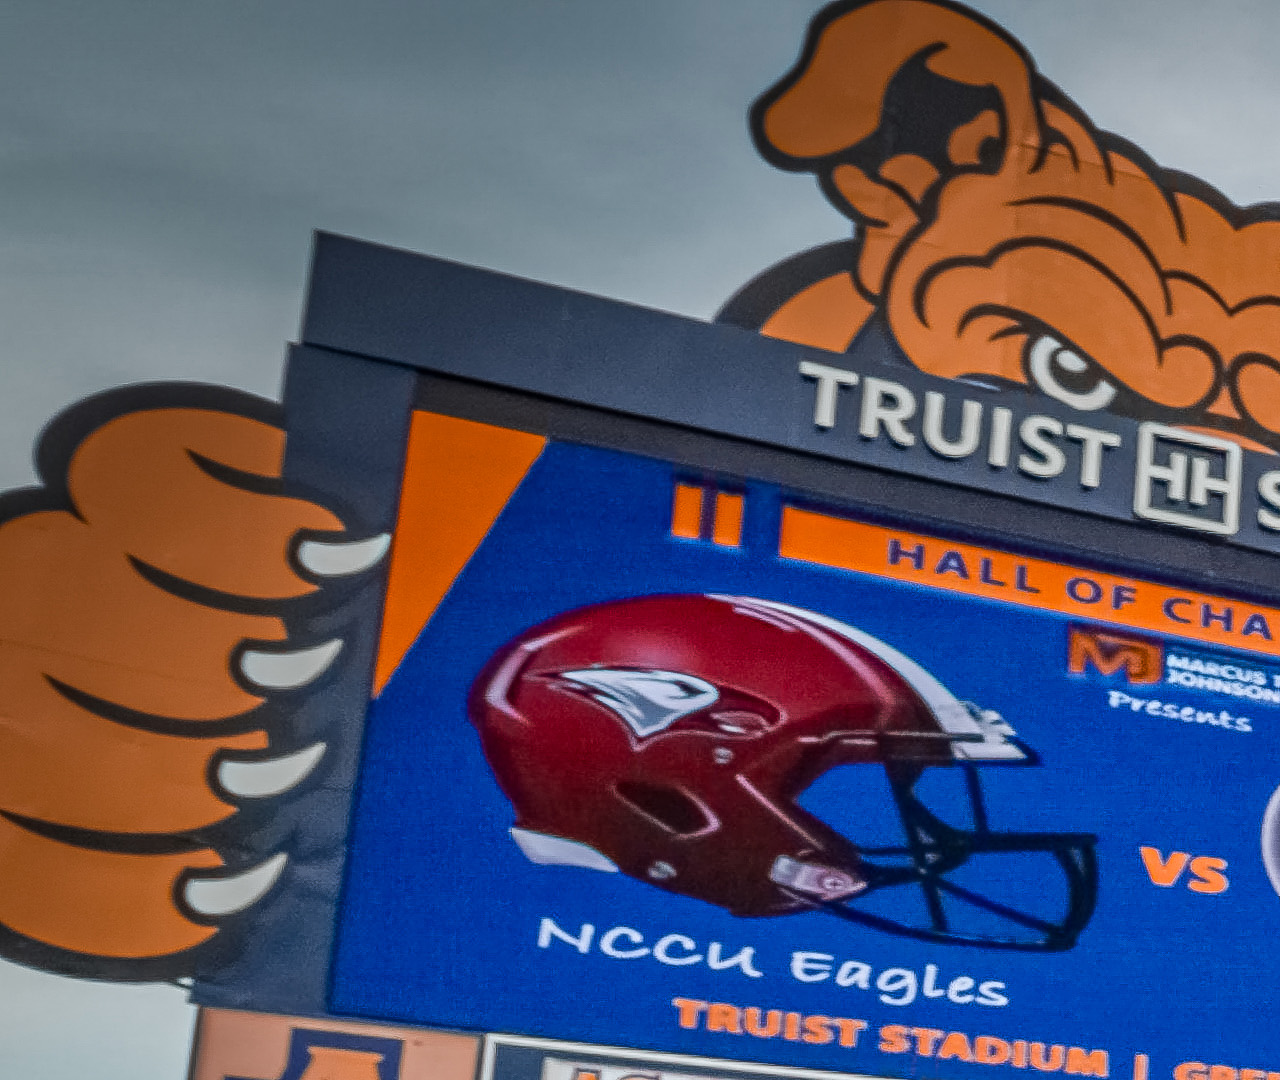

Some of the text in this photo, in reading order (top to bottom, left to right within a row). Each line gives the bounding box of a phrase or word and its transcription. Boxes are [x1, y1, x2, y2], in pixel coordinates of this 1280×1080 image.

[799, 361, 1121, 488] TRUIST
[887, 539, 1040, 594] HALL
[1065, 577, 1137, 611] OF
[1166, 654, 1267, 686] MARCUS
[1107, 690, 1253, 733] Presents
[1139, 846, 1229, 894] VS
[537, 917, 1010, 1006] NCCU Eagles
[671, 997, 869, 1048] TRUIST
[877, 1025, 1110, 1079] STADIUM
